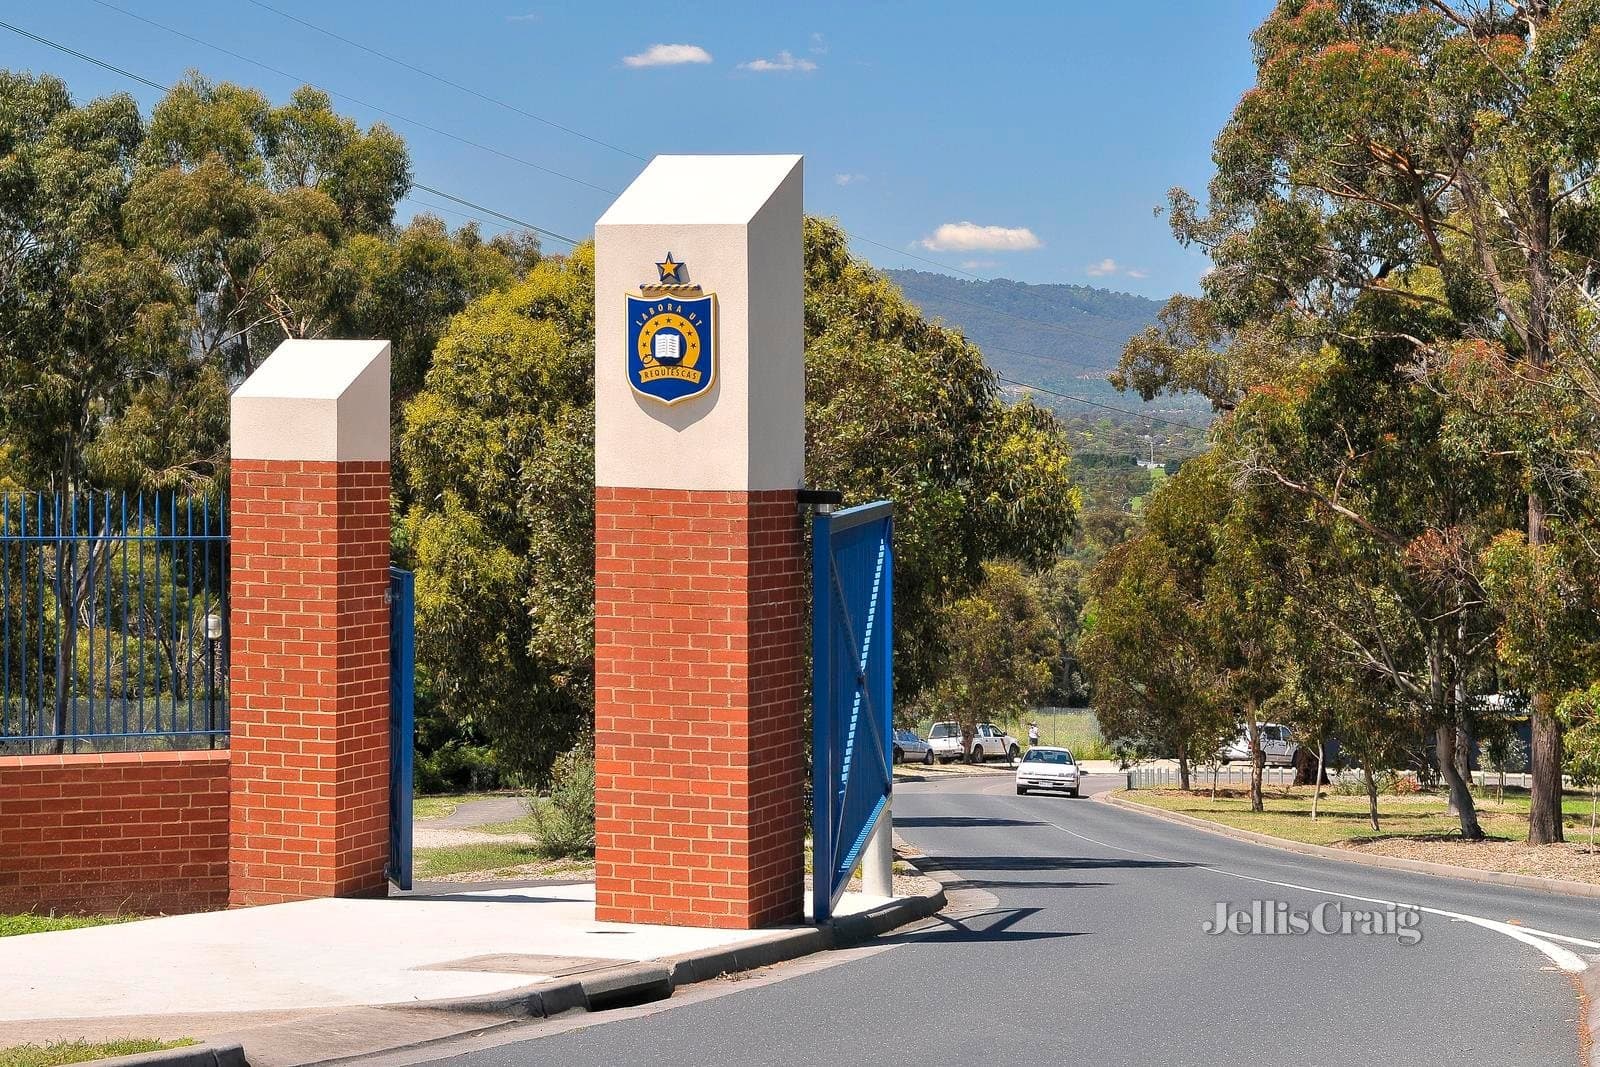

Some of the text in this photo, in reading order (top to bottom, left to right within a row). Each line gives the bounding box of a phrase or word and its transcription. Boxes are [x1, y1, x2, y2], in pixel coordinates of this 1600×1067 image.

[636, 303, 702, 326] LABORA UT
[644, 368, 697, 380] REQUIESCAS
